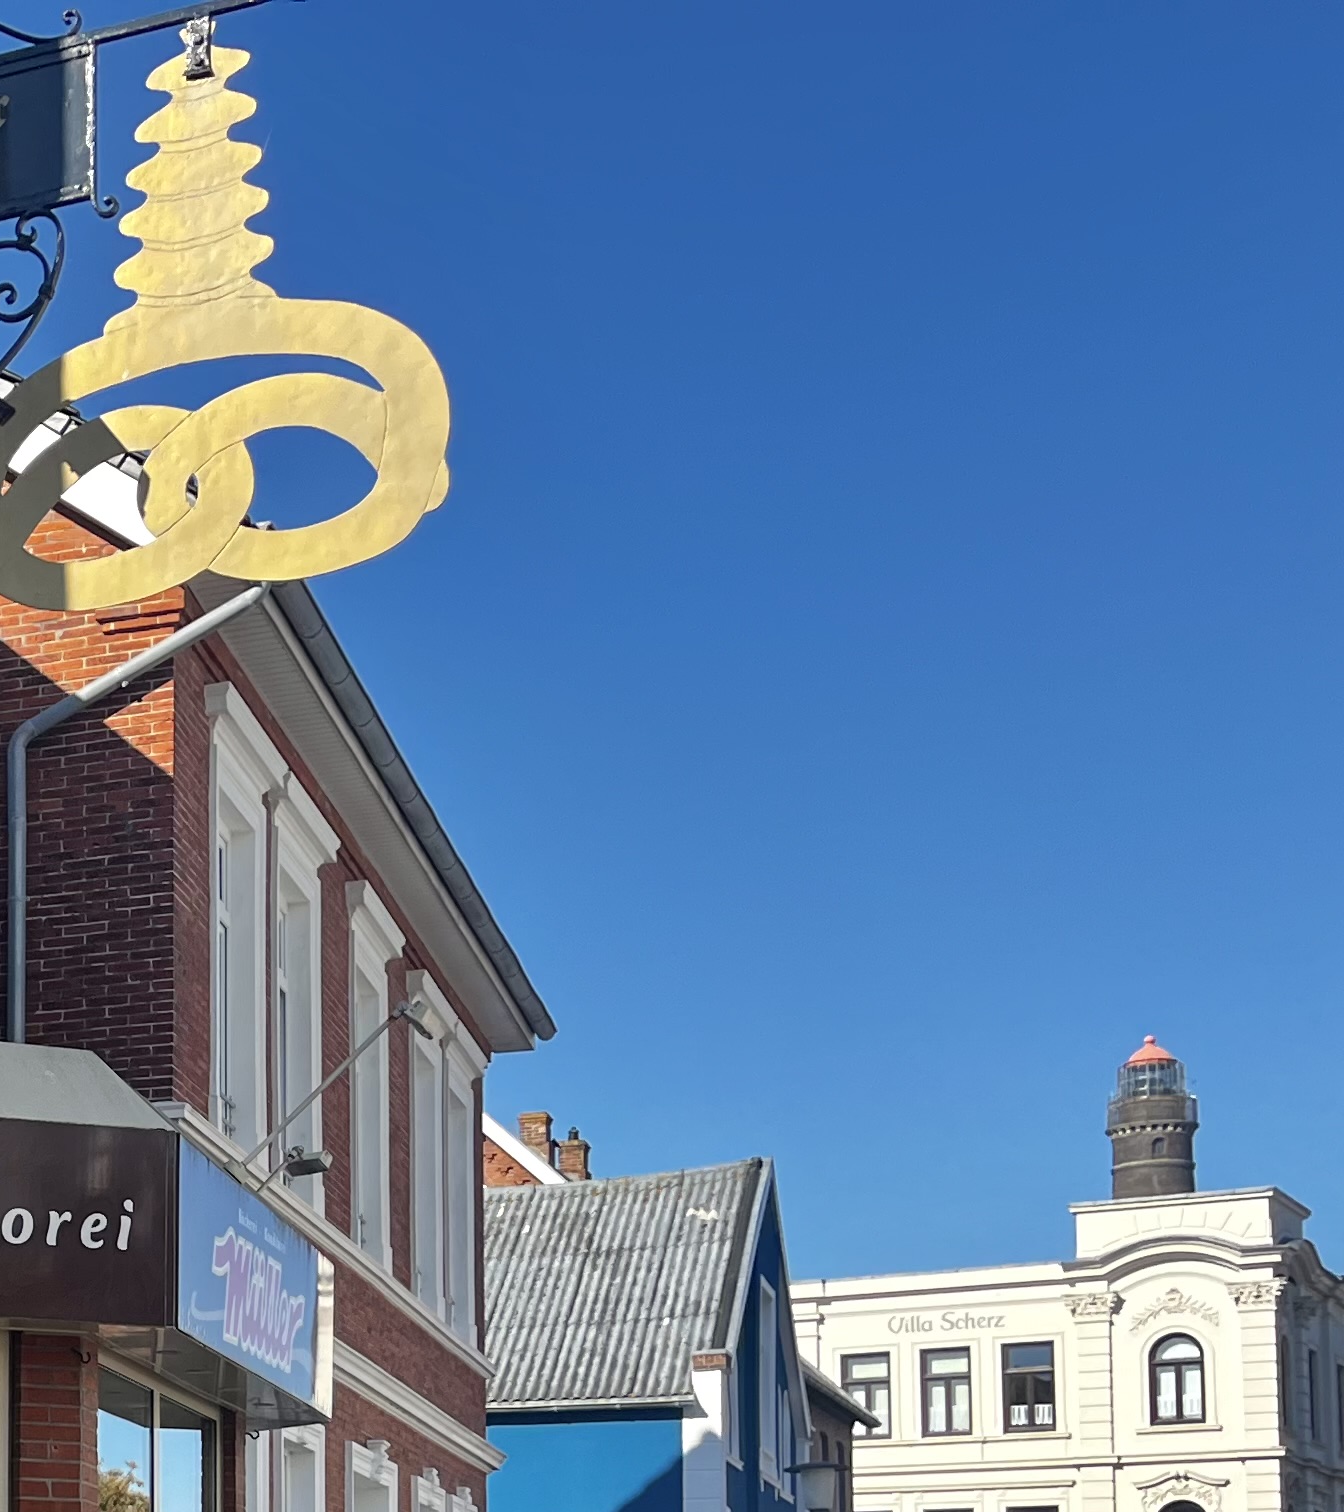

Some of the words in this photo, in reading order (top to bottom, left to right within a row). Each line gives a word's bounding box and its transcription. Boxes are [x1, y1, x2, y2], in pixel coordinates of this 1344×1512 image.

[212, 1226, 307, 1374] Müller
[888, 1314, 933, 1334] Villa
[940, 1311, 1006, 1332] Scherz
